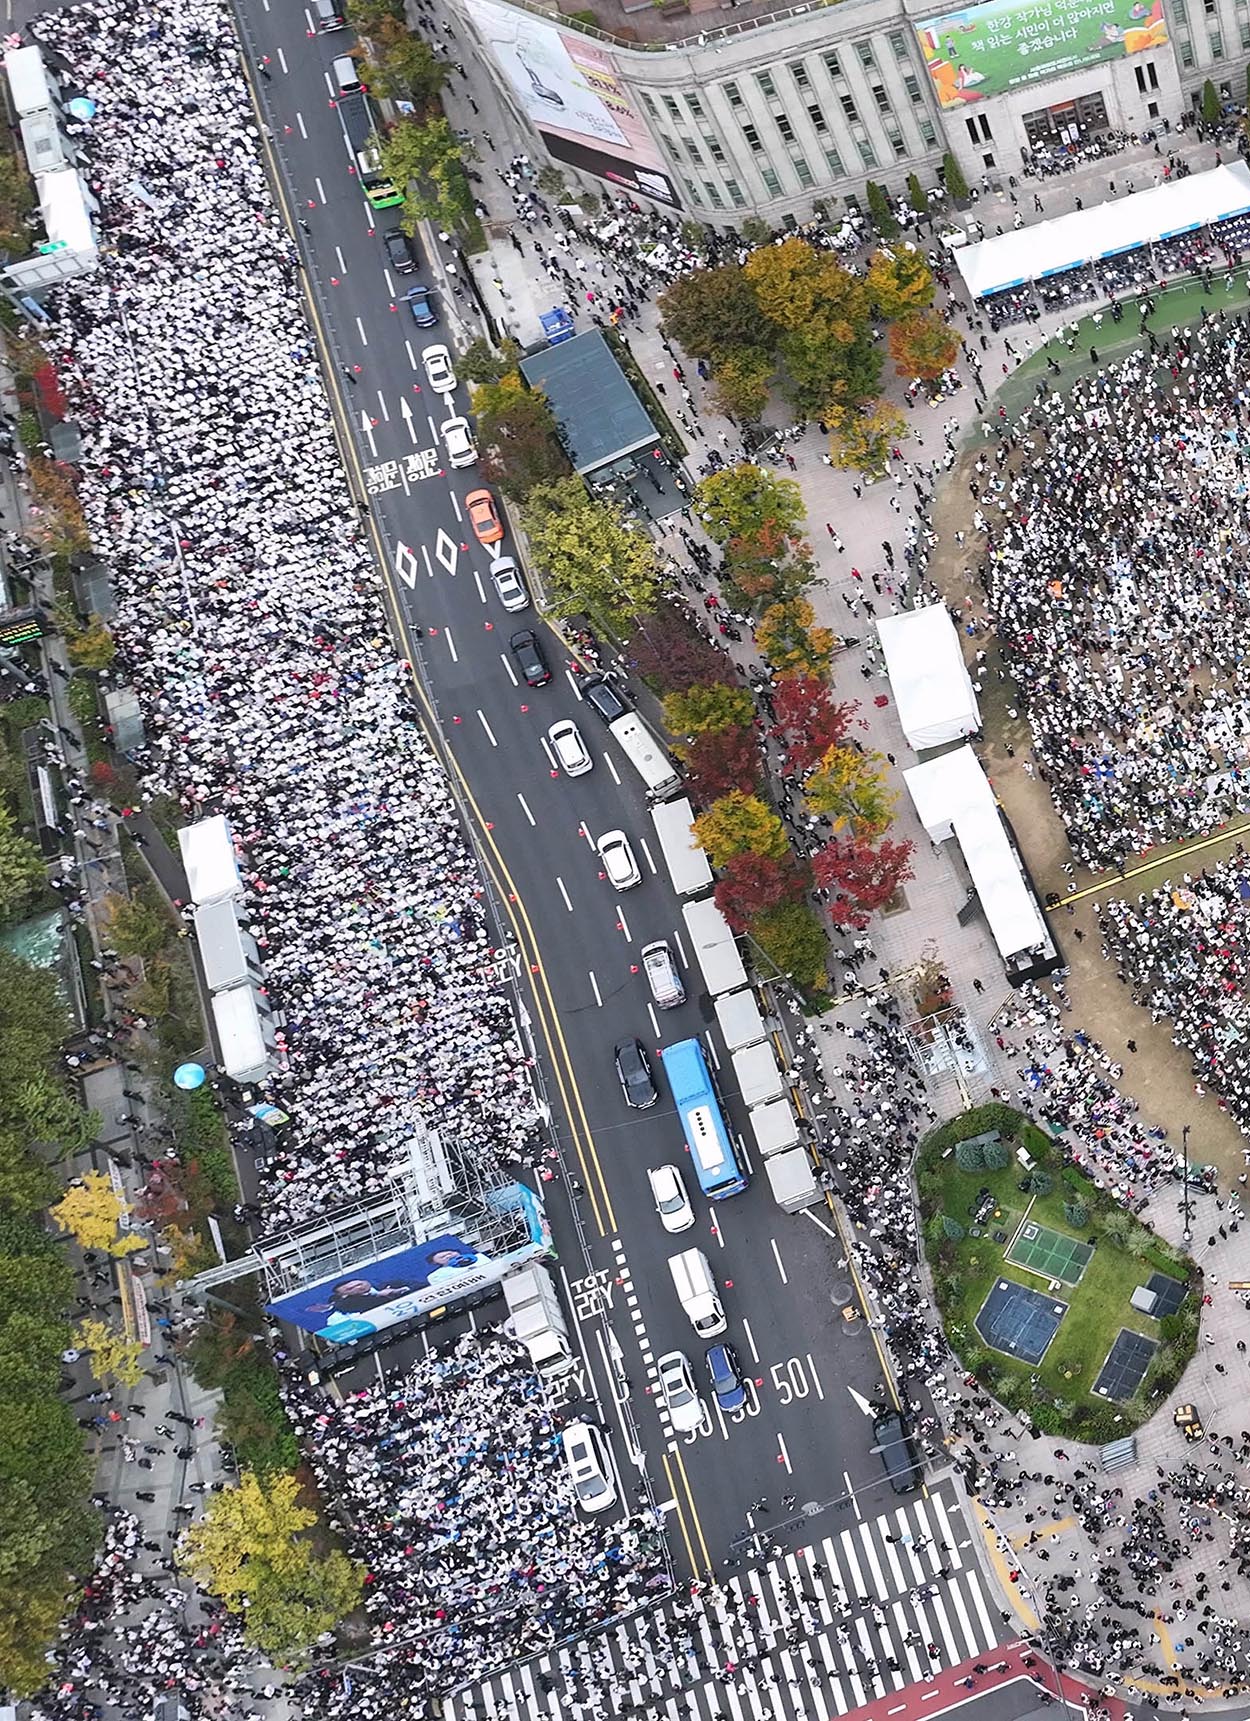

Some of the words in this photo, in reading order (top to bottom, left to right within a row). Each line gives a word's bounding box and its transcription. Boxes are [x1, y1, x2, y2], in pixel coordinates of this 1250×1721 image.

[987, 16, 1012, 33] 한강
[1016, 3, 1053, 22] 작가님
[987, 33, 1013, 49] 읽는
[1016, 20, 1050, 40] 시민이
[1053, 17, 1065, 27] 더
[1067, 1, 1115, 24] 많아지면
[1016, 27, 1078, 56] 좋겠습니다
[363, 460, 402, 495] 광화문
[403, 448, 443, 482] 광화문
[770, 1356, 810, 1405] 50
